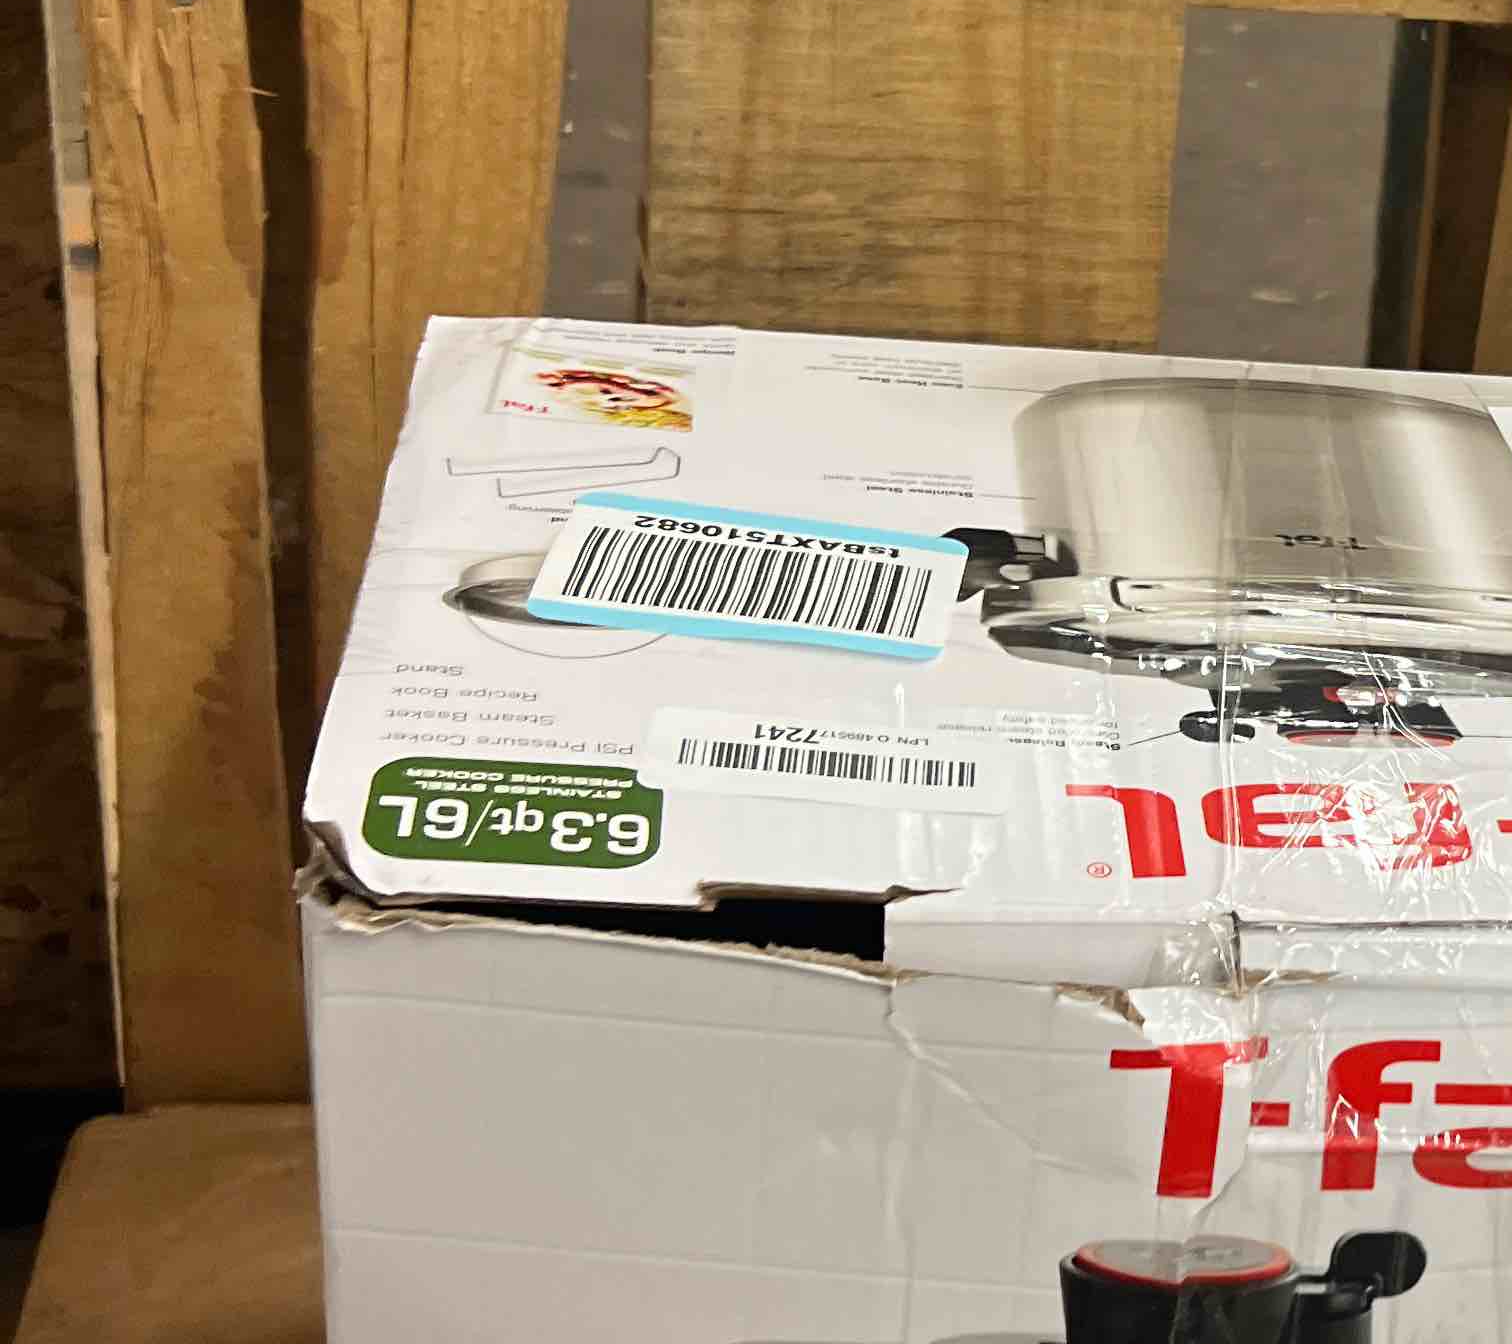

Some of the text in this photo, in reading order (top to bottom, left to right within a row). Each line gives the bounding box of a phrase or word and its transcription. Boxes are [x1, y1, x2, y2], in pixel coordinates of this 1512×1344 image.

[632, 513, 902, 560] tsBAXT510682
[395, 663, 465, 678] Stand
[391, 686, 538, 703] Recipe Book
[382, 708, 557, 726] Steam Basket
[379, 731, 635, 756] PSI Pressure Cooker
[897, 735, 929, 748] LPN
[404, 768, 634, 788] PRESSURE COOKER
[414, 779, 623, 800] STAINLESS STEEL
